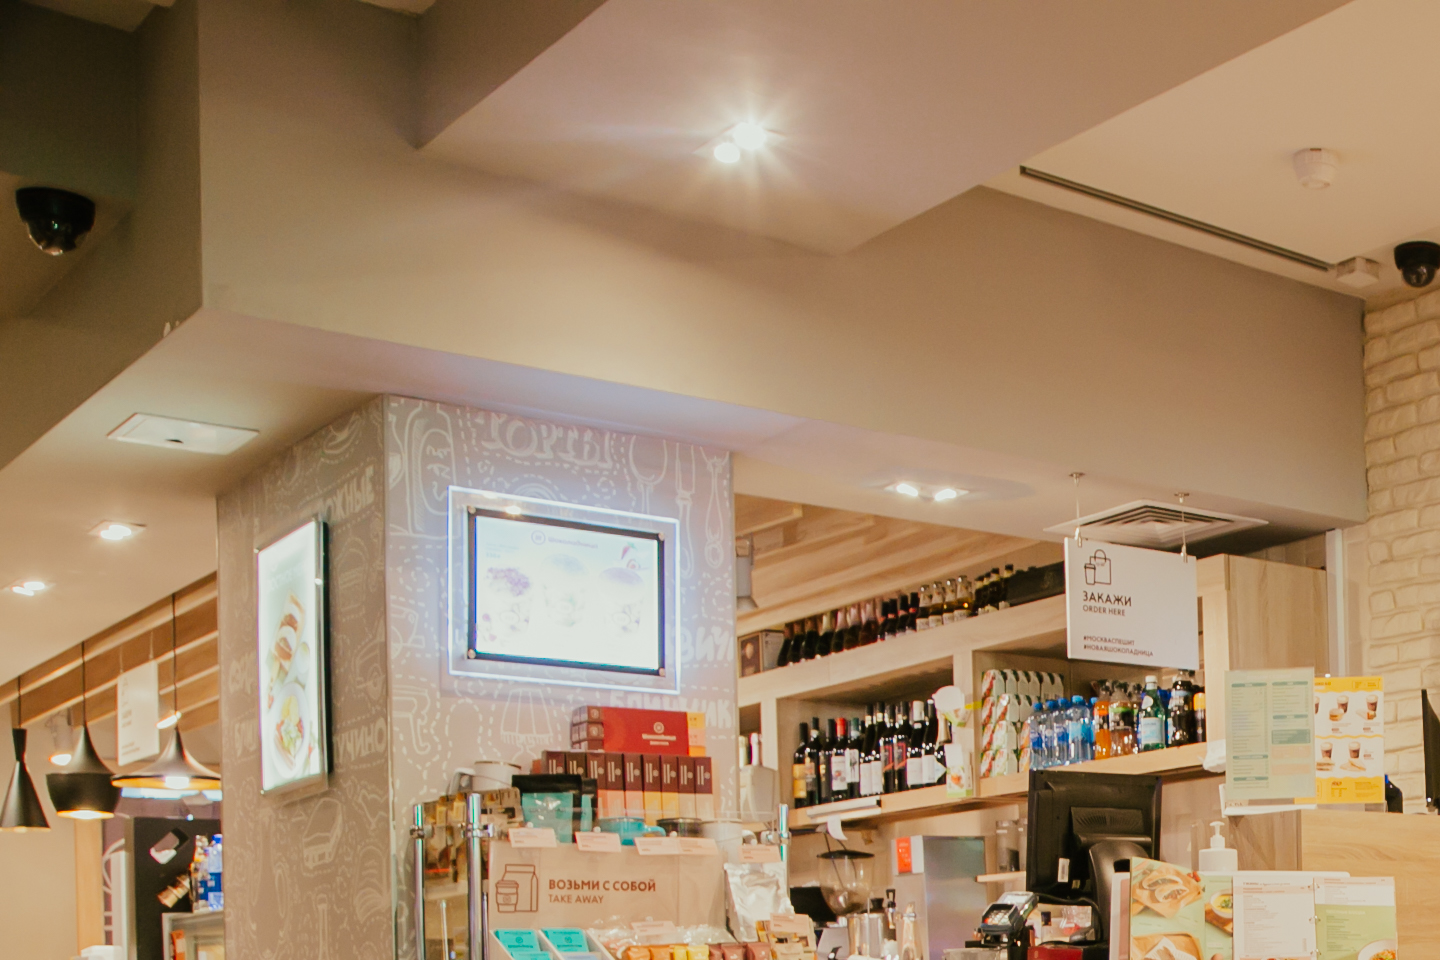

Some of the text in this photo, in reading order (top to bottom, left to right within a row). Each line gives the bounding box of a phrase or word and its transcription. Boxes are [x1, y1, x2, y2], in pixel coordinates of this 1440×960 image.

[1083, 590, 1131, 606] ЗАКАЖИ
[1083, 605, 1125, 616] ORDER HERE
[548, 879, 656, 892] ВОЗЬМИ С СОБОЙ
[548, 894, 604, 904] TAKE AWAY
